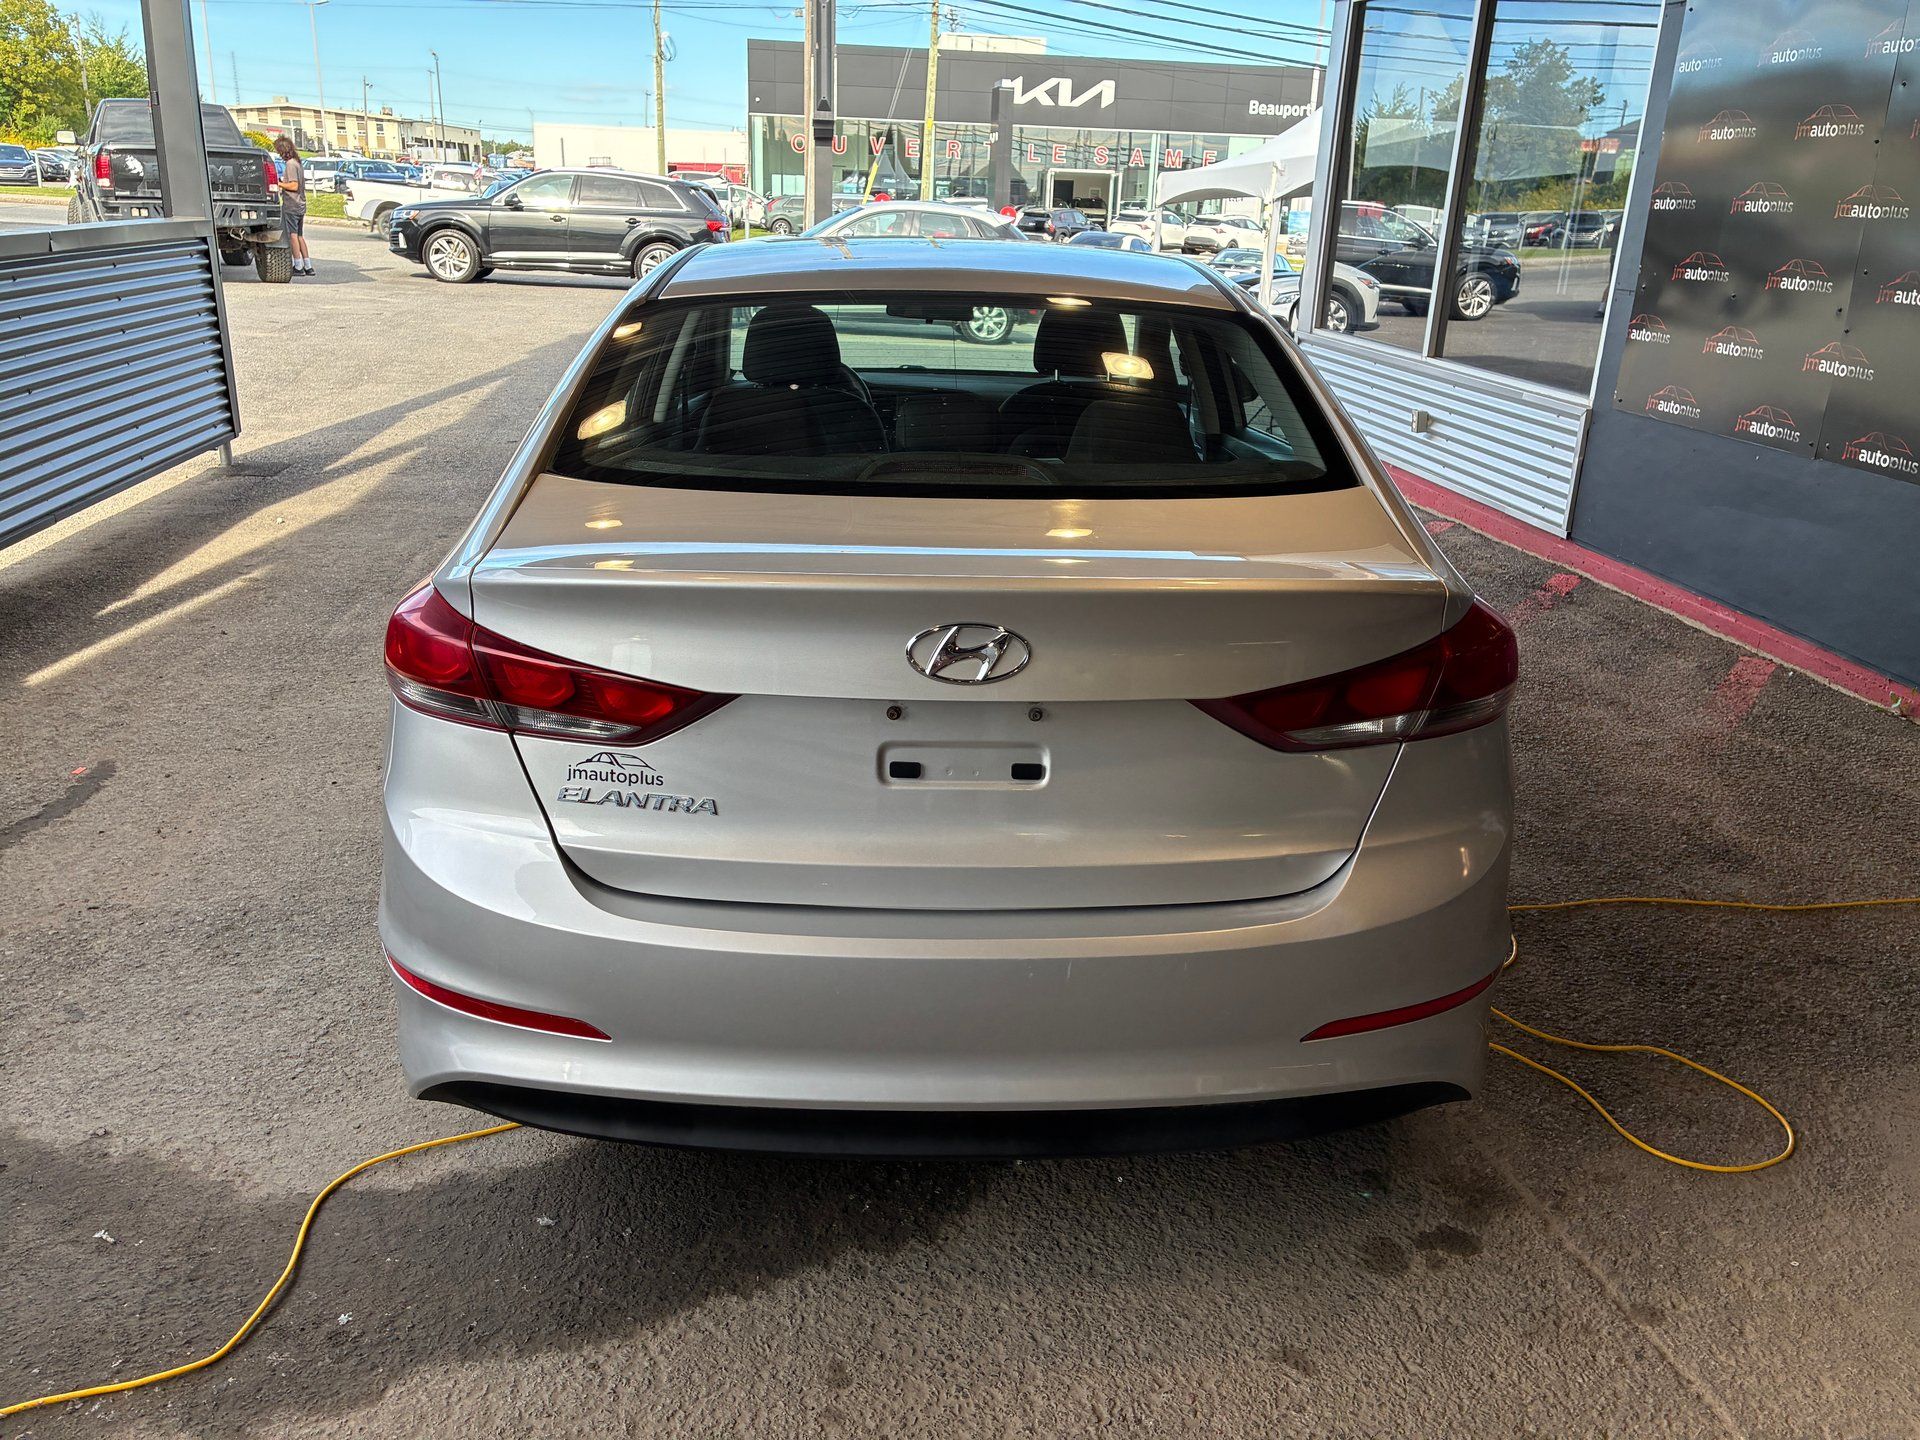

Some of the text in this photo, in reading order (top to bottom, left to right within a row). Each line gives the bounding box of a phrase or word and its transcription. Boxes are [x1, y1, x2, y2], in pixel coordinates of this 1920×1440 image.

[1248, 99, 1312, 119] Beauport
[1697, 125, 1757, 144] jmautoplus
[1794, 121, 1865, 141] jmautoplus
[1730, 197, 1794, 215] jmautoplus
[1834, 200, 1910, 220] jmautoplus
[1671, 264, 1730, 283] jmautoplus
[1765, 272, 1833, 294] jmautoplus
[1702, 337, 1764, 360] jmautoplus
[1802, 353, 1875, 382] jmautoplus
[1645, 394, 1701, 418] jmautoplus
[1734, 414, 1801, 443] jmautoplus
[1841, 441, 1920, 474] jmautoplus
[567, 764, 664, 787] jmautoplus
[556, 785, 719, 816] ELANTRA
